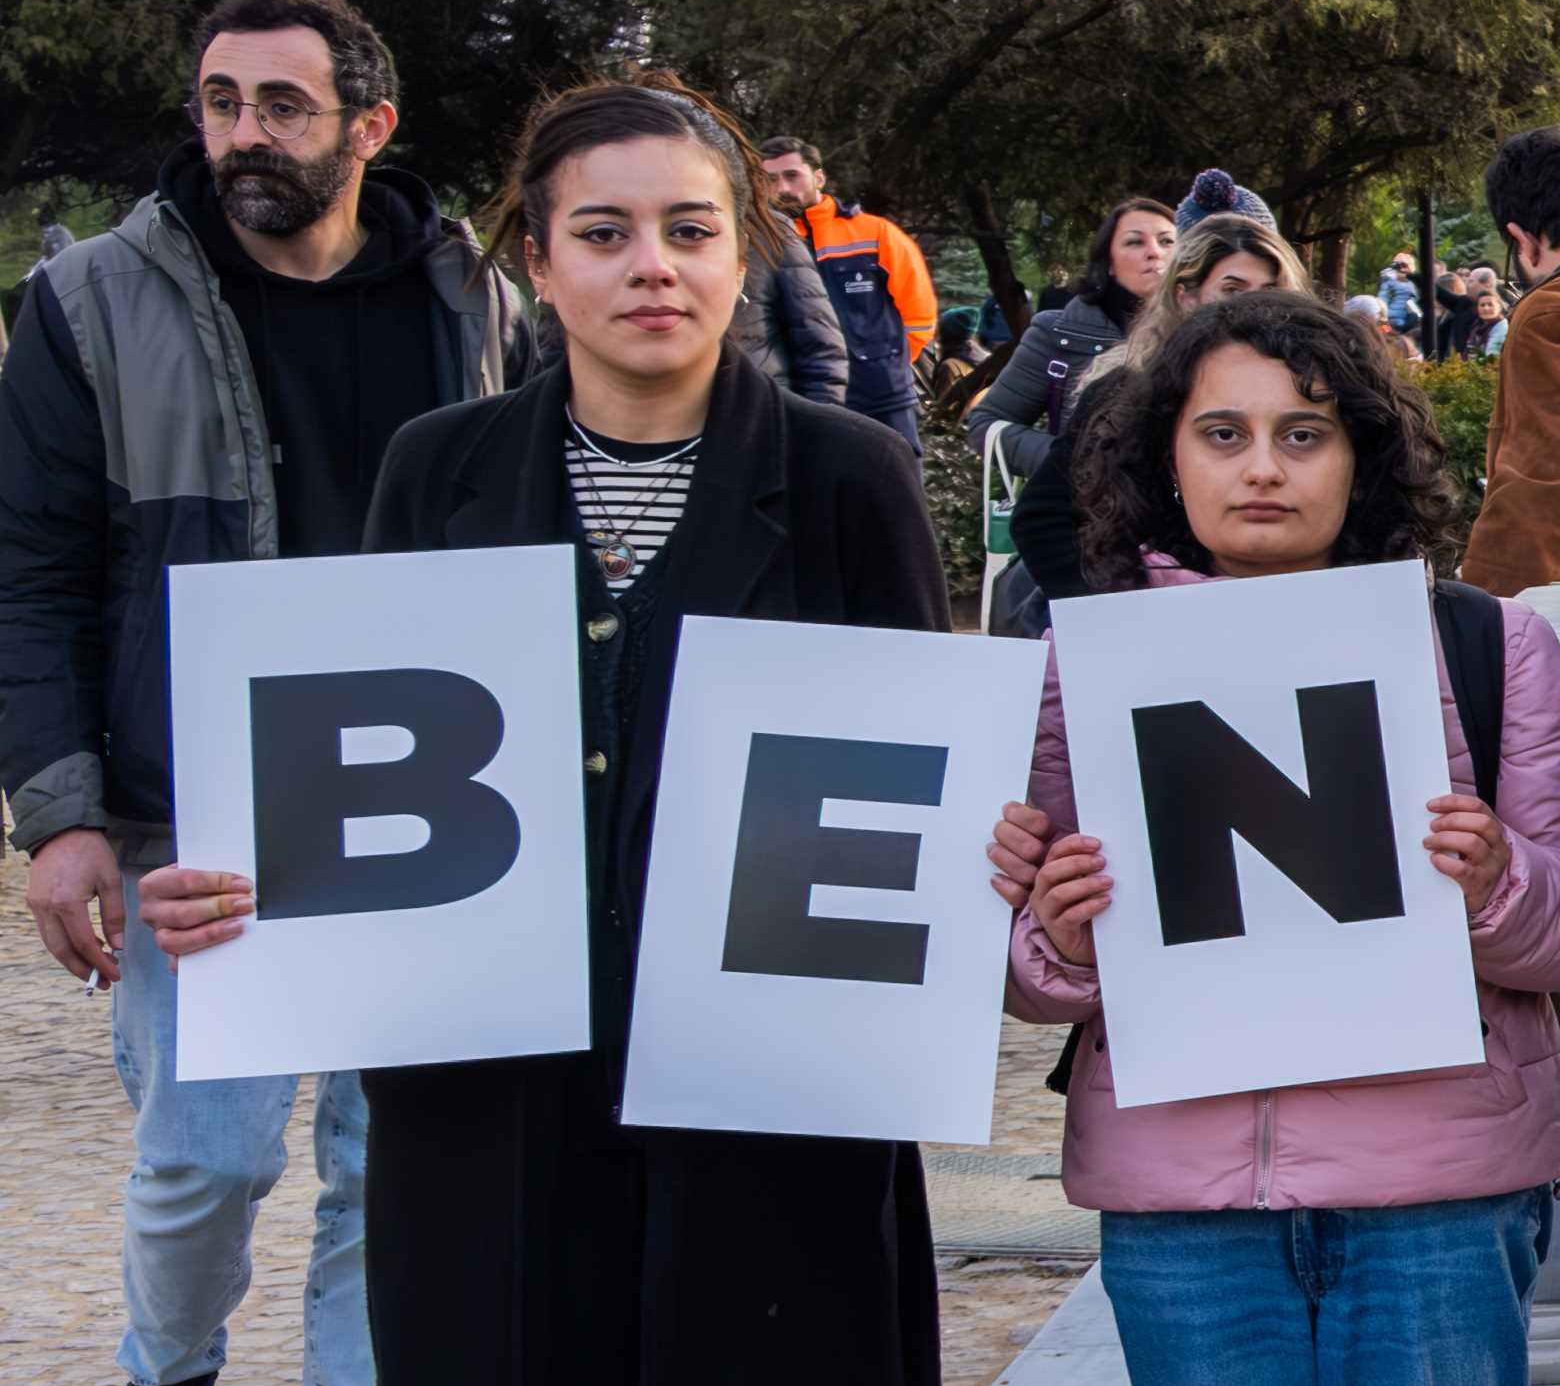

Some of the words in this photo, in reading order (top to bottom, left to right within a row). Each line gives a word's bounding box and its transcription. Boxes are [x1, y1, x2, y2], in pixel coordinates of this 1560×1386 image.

[249, 668, 521, 921] B
[721, 732, 949, 985] E
[1131, 680, 1405, 946] N
